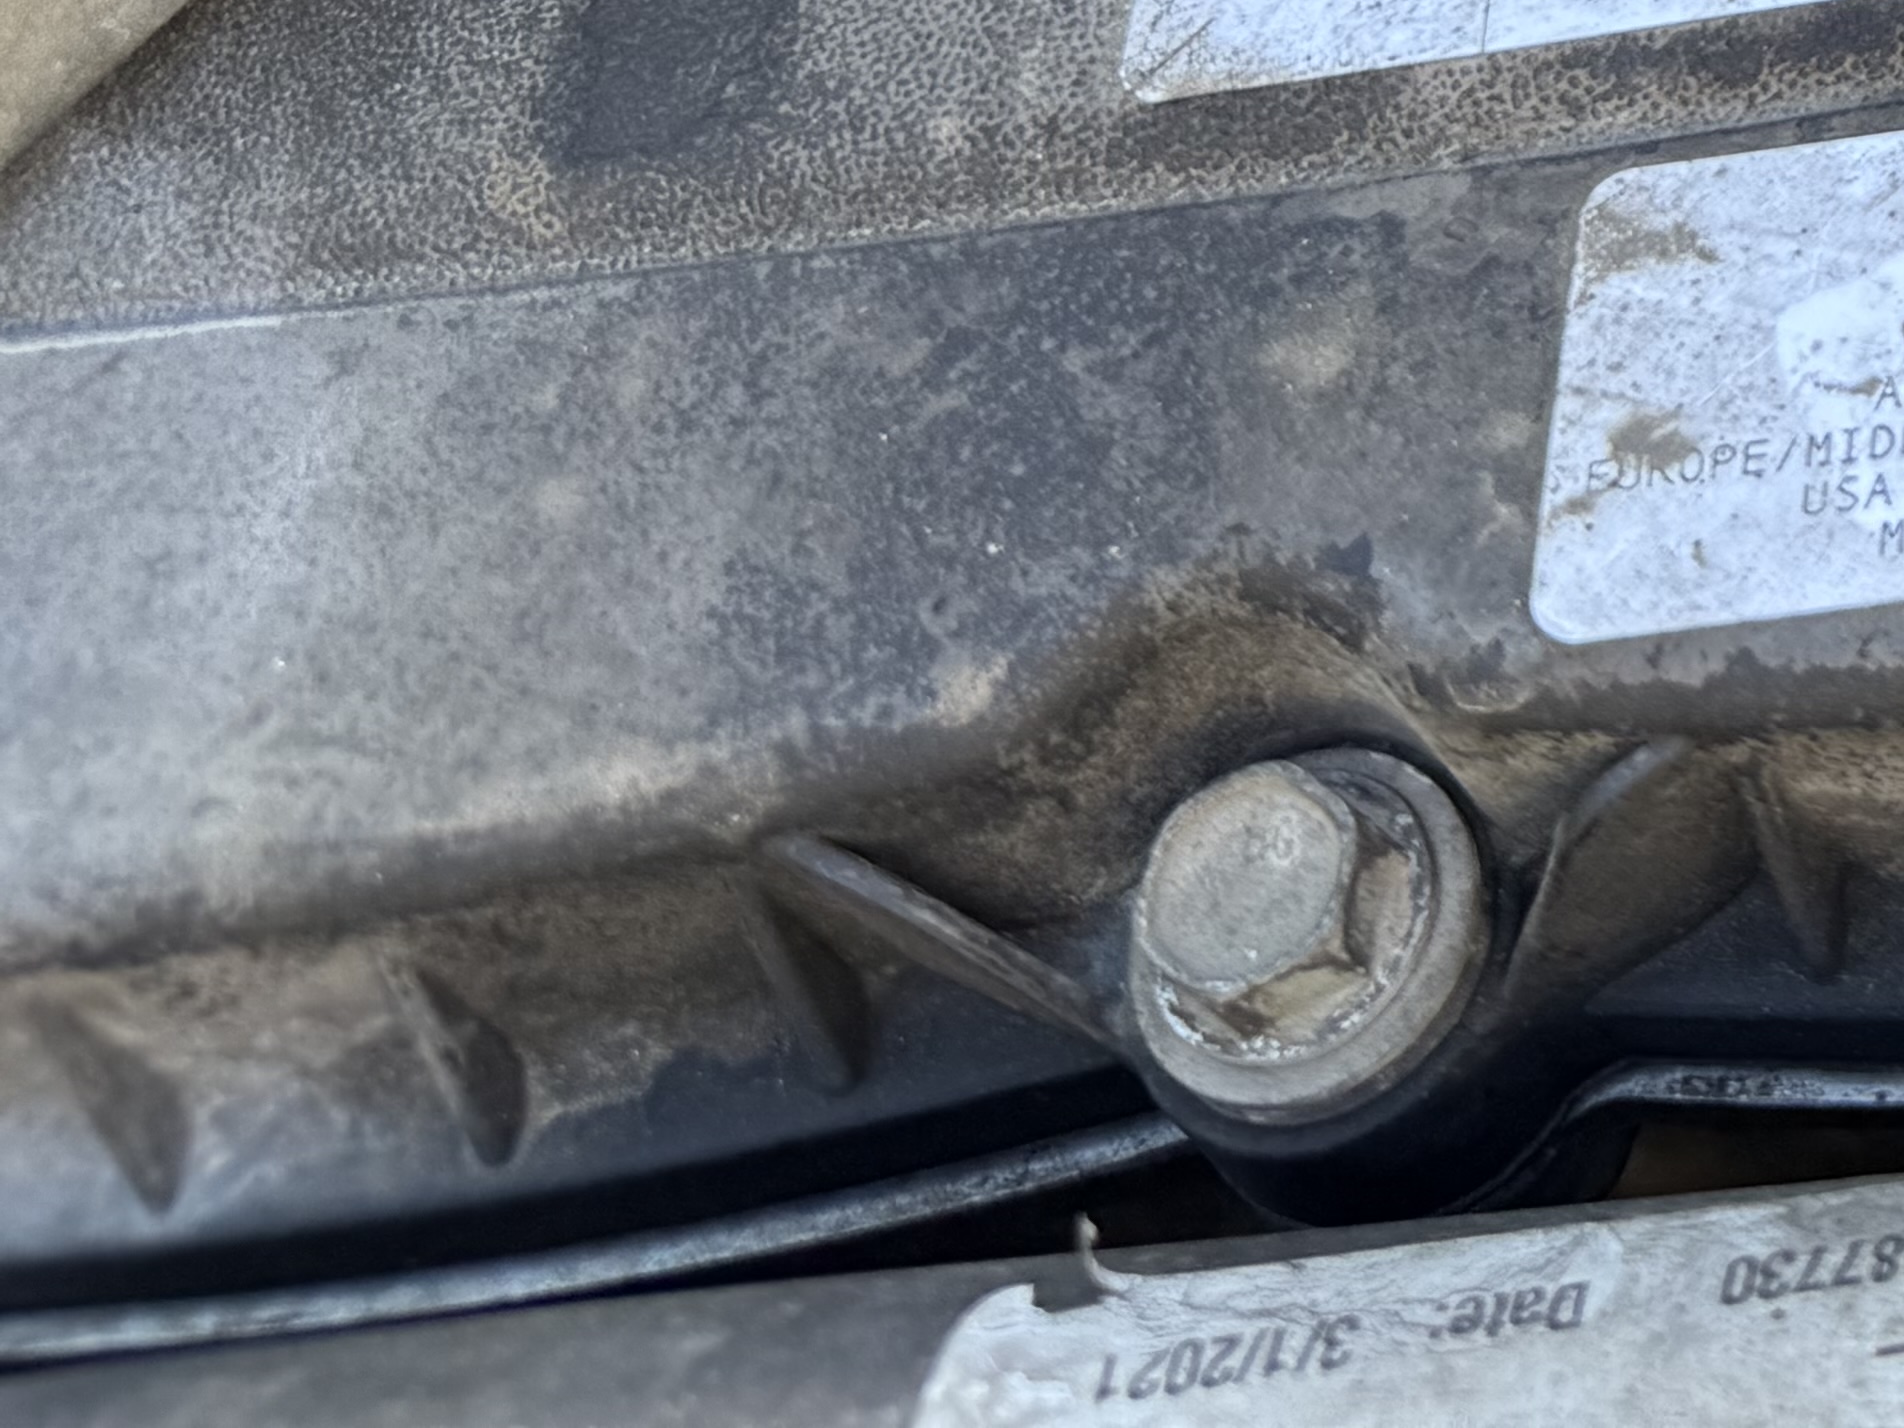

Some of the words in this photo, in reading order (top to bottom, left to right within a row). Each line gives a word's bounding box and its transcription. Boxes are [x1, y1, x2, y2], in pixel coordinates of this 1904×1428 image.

[1798, 469, 1893, 521] USA
[1429, 1278, 1591, 1341] Date:
[1093, 1312, 1362, 1404] 3/1/2021
